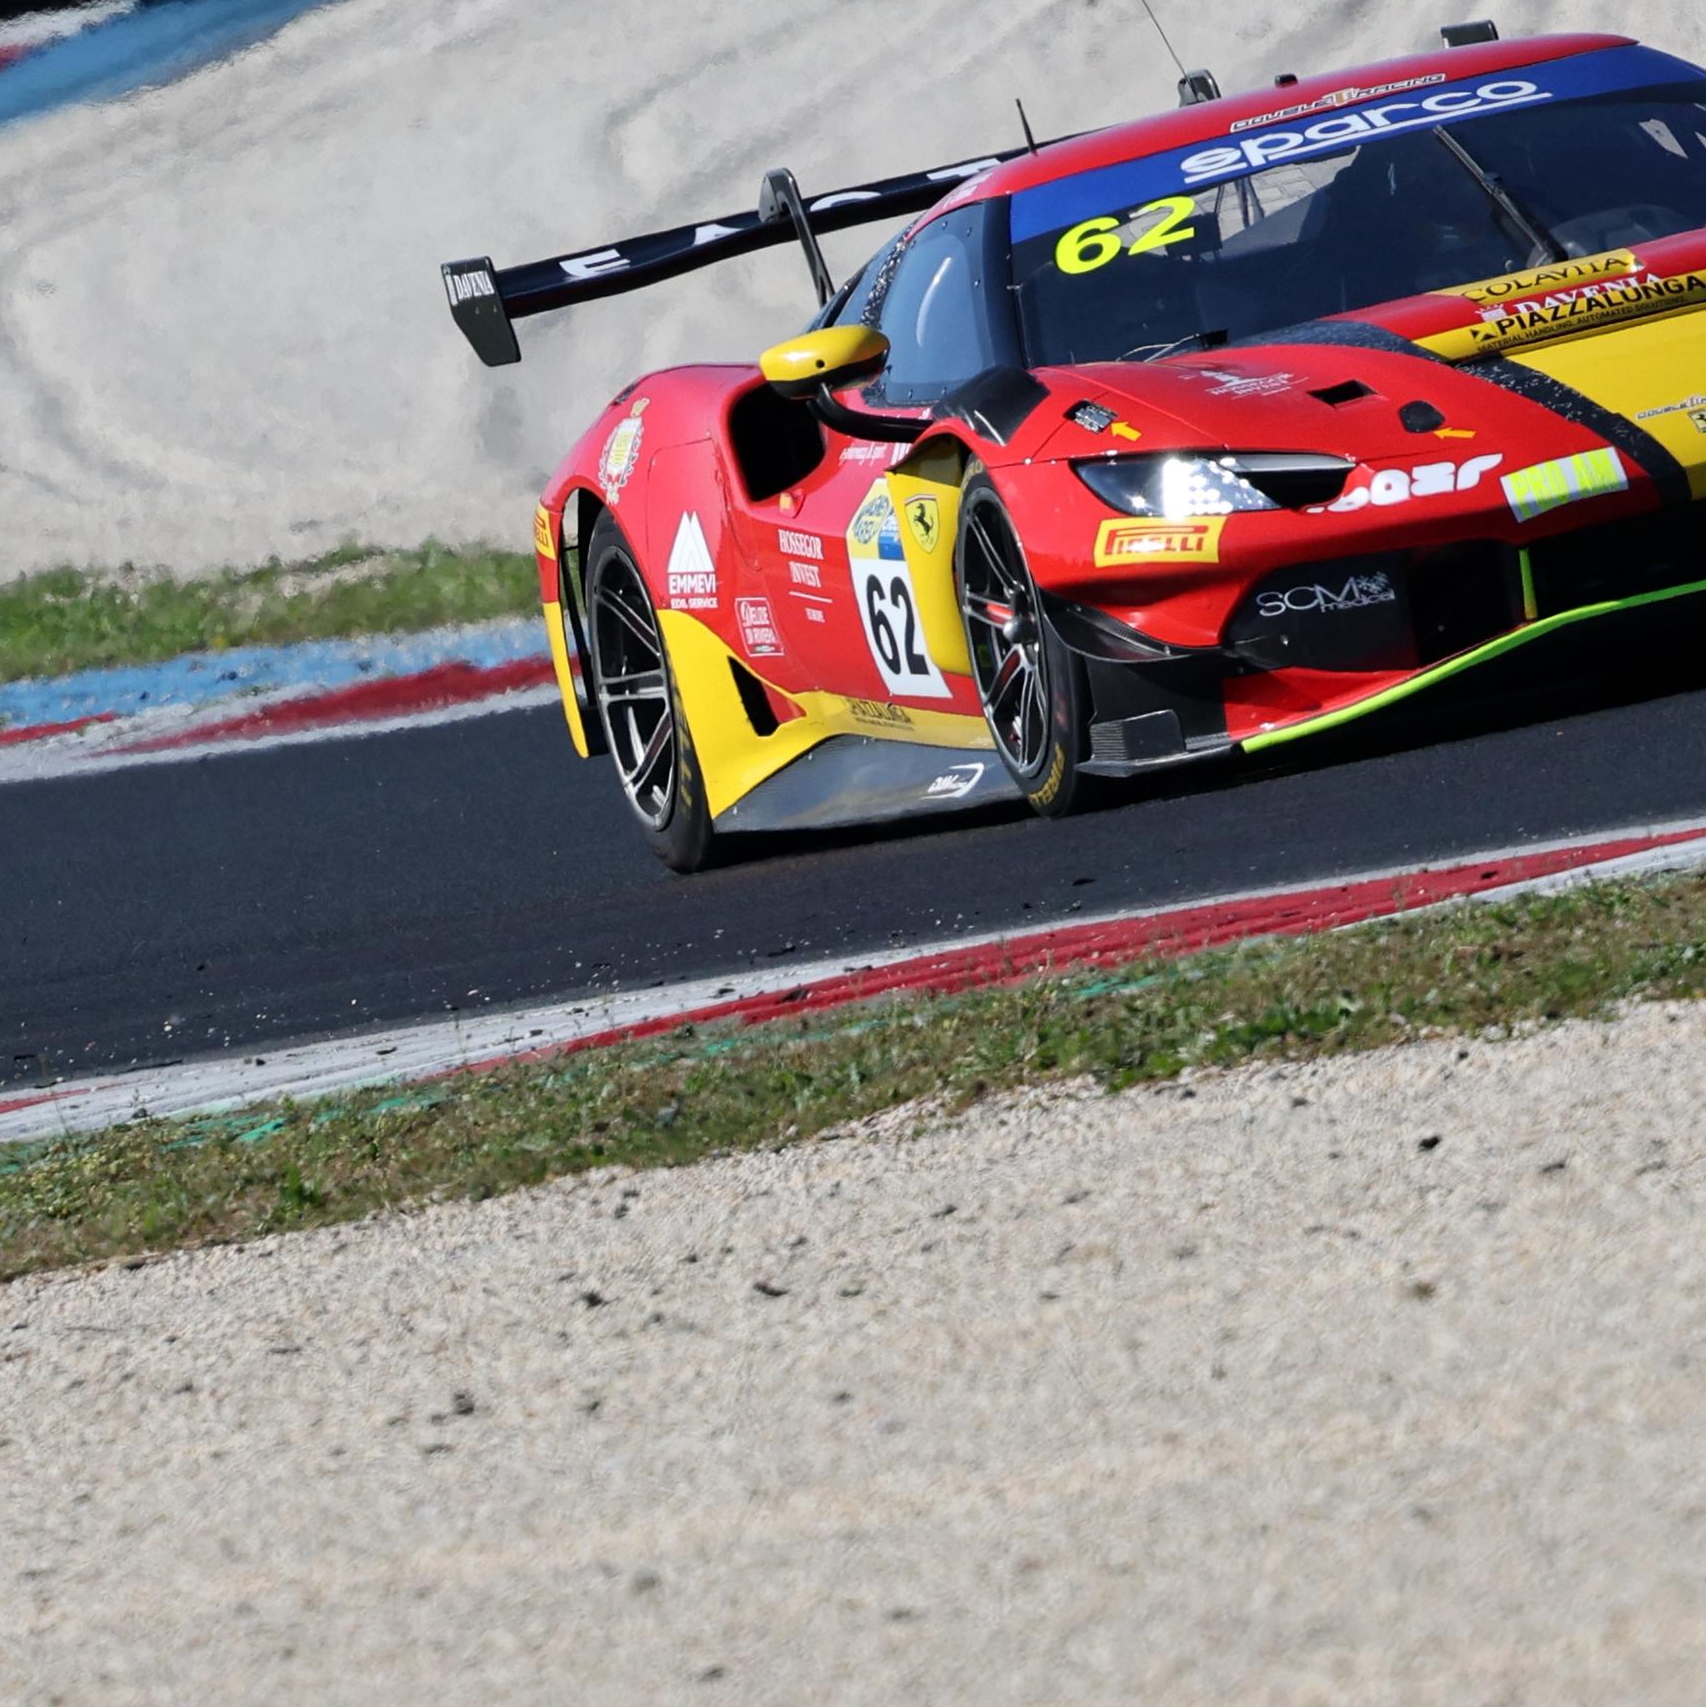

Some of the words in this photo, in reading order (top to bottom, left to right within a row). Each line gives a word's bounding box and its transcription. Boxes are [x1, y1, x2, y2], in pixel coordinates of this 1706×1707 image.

[1181, 80, 1539, 175] sparco
[1055, 197, 1195, 275] 62
[1496, 274, 1706, 336] PIAZZALUNGA
[777, 528, 824, 560] HOSSEGOR
[668, 573, 717, 595] EMMEVI
[788, 561, 822, 588] INVEST
[688, 597, 719, 610] SERVICE
[1256, 576, 1361, 617] SCM
[866, 573, 931, 676] 62
